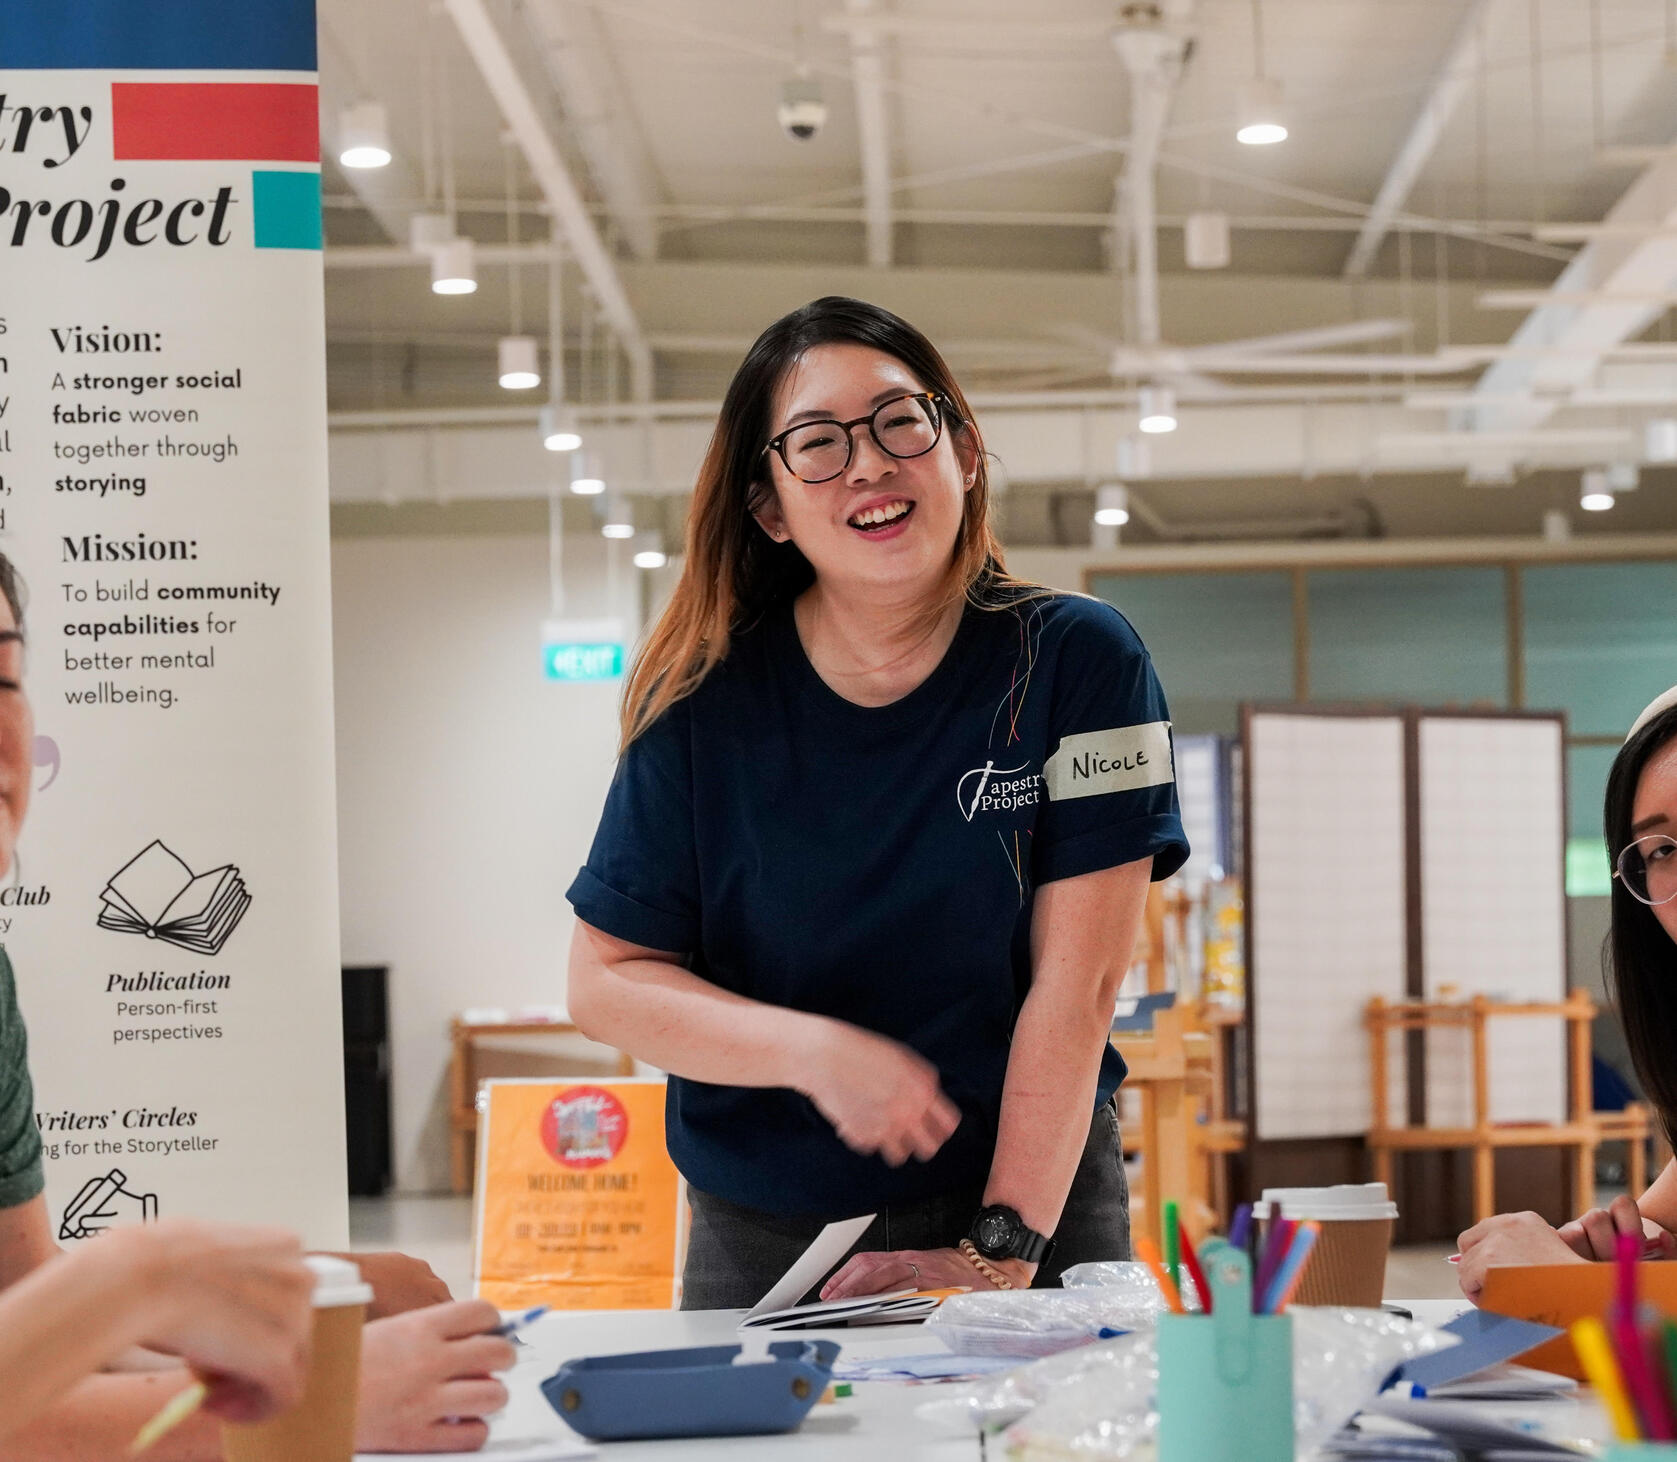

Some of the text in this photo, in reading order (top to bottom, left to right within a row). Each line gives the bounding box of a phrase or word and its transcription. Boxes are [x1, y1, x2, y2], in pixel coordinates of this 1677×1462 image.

[0, 178, 239, 263] roject
[50, 325, 163, 353] Vision:
[51, 368, 242, 396] A stronger social
[53, 403, 199, 425] fabric woven
[54, 434, 239, 465] together through
[55, 473, 147, 498] storying
[62, 532, 199, 563] Mission:
[62, 578, 282, 607] To build community
[63, 611, 237, 643] capabilities for
[64, 645, 215, 671] better mental
[65, 681, 179, 710] wellbeing.
[981, 789, 1040, 812] Project
[0, 885, 51, 908] Club
[105, 969, 231, 993] Publication
[117, 999, 218, 1016] Person-first
[113, 1024, 223, 1045] perspectives
[122, 1105, 198, 1130] Circles
[64, 1140, 90, 1156] for
[94, 1139, 123, 1155] the
[127, 1136, 219, 1157] Storyteller
